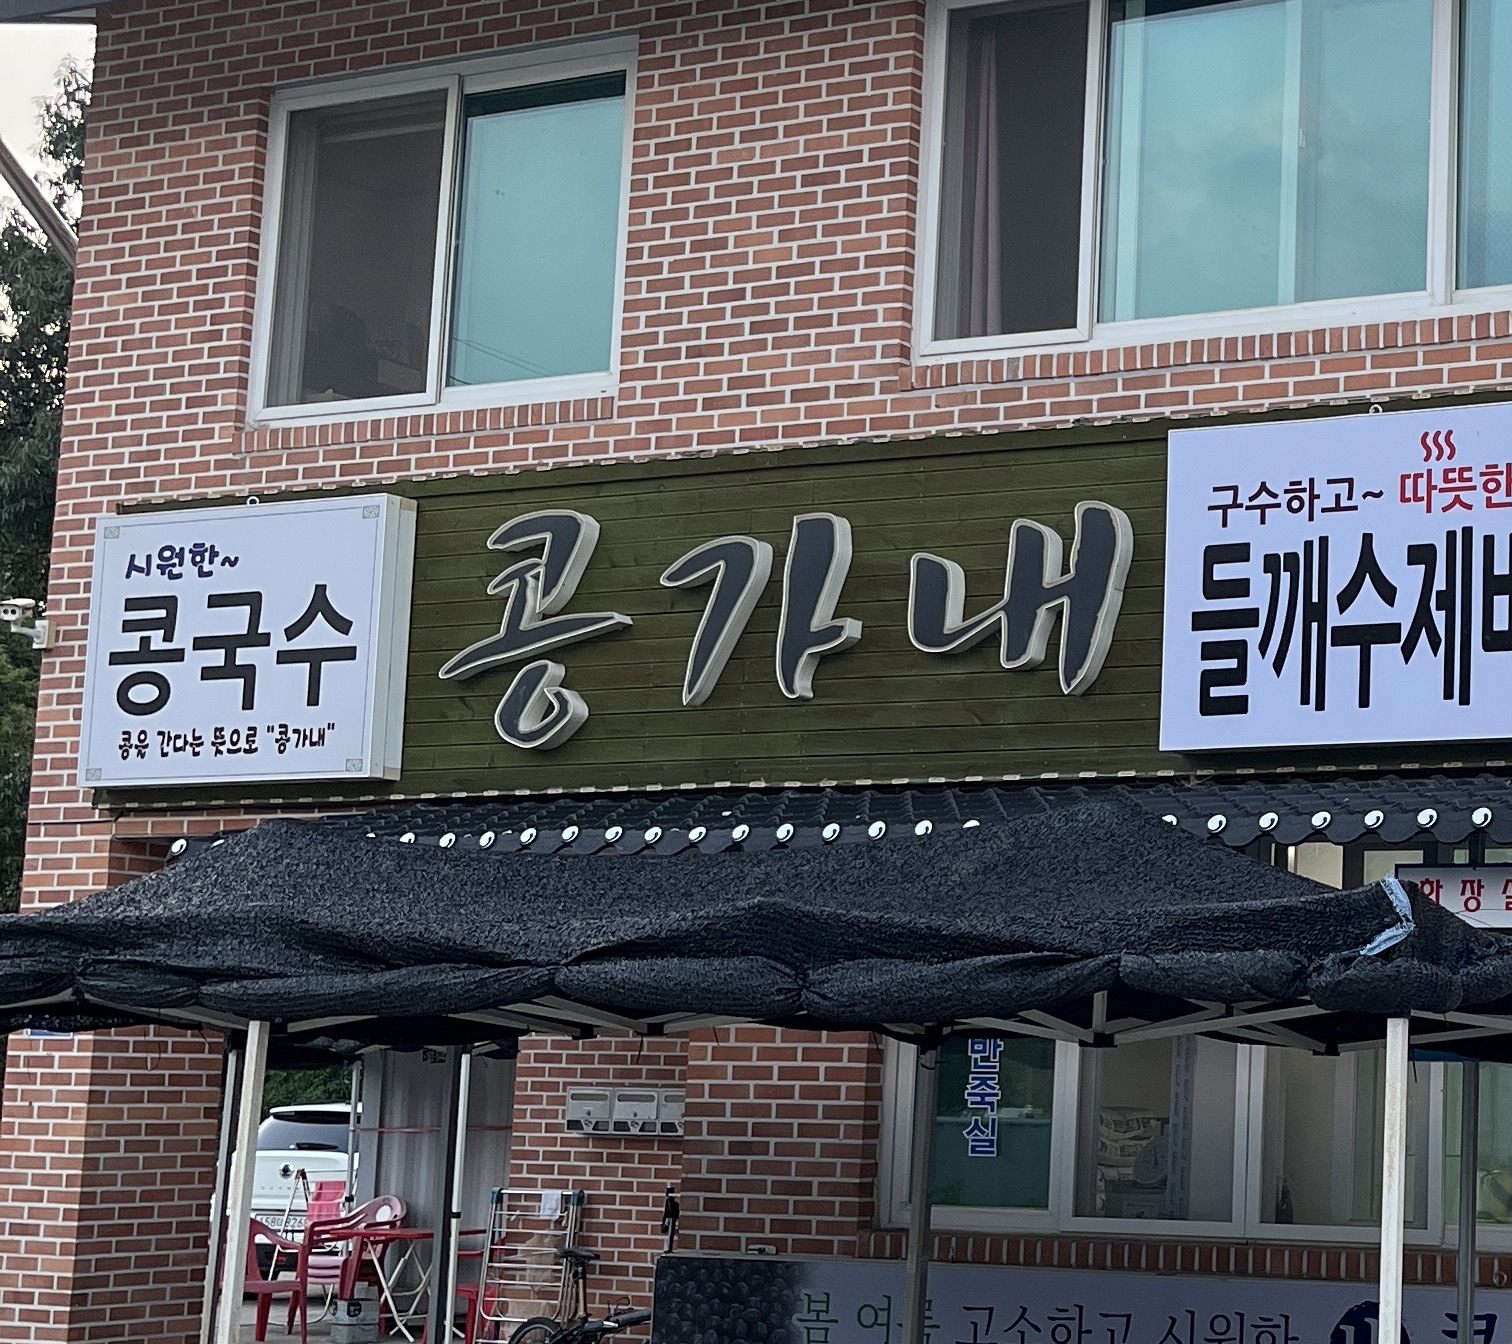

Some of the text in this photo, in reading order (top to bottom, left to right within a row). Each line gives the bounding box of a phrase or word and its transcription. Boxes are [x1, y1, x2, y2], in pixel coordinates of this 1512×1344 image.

[1207, 476, 1384, 528] 구수하고~
[125, 542, 240, 581] 시원한~
[108, 583, 358, 716] 콩국수
[118, 722, 336, 760] 콩을 간다는 뜻으로 "콩가내"
[963, 1039, 1004, 1157] 반죽실
[796, 1292, 839, 1344] 봄
